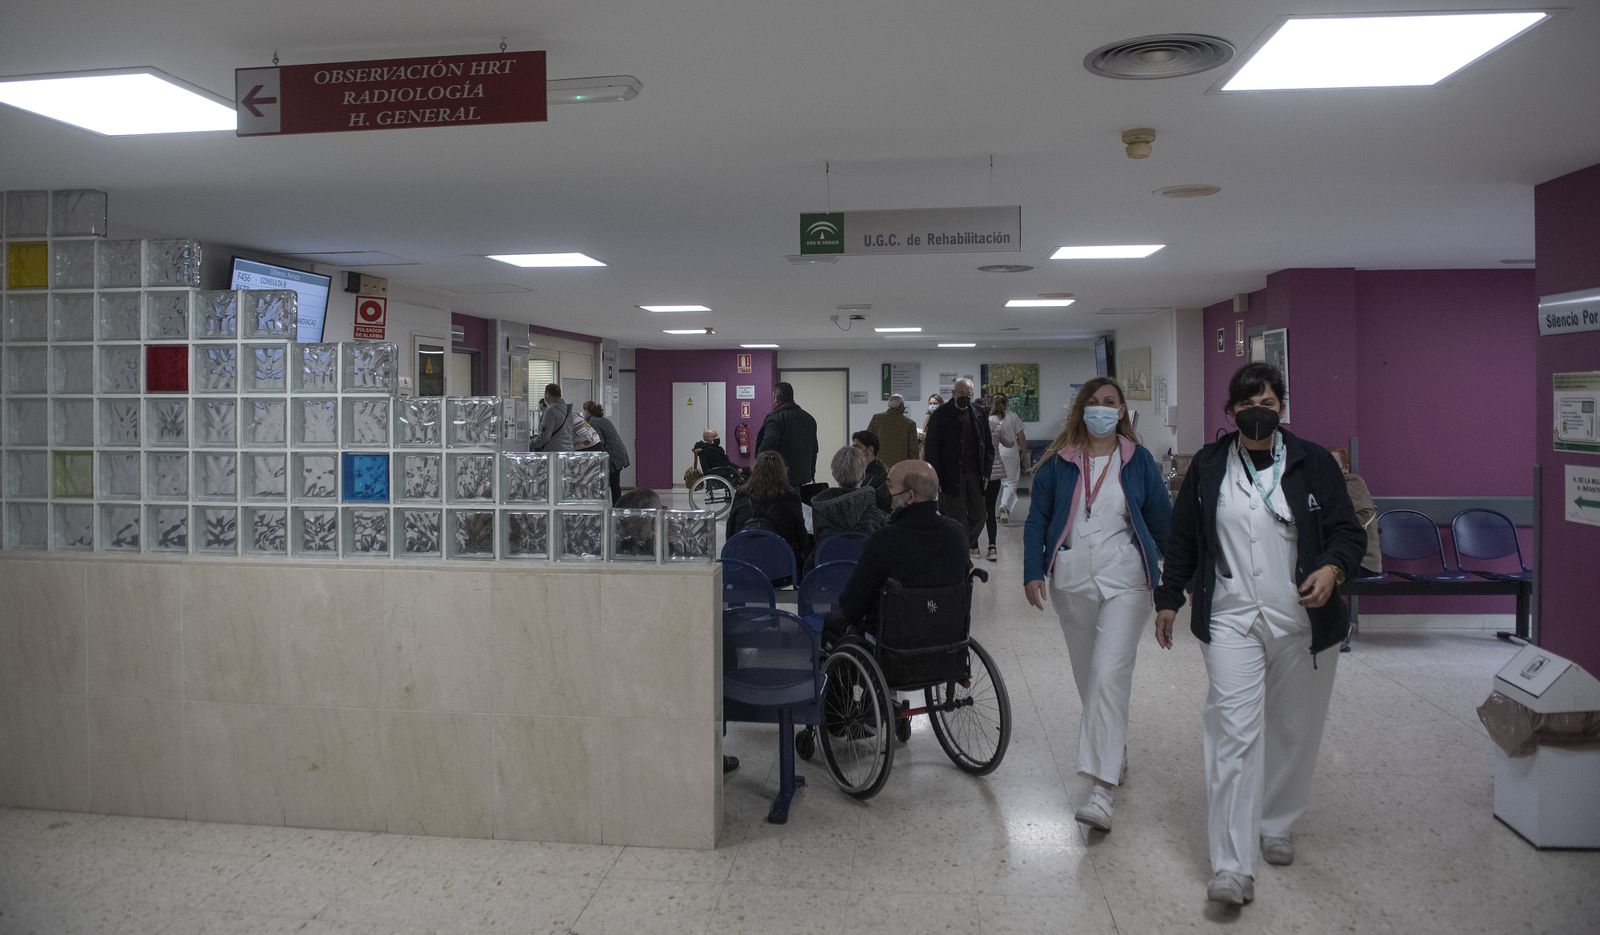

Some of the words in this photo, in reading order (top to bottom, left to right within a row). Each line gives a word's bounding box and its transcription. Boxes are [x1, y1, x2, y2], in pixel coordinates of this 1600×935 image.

[313, 60, 464, 85] OBSERVACIÓN
[469, 59, 517, 76] HRT
[342, 80, 485, 105] RADIOLOGÍA
[347, 112, 370, 127] H.
[376, 106, 481, 125] GENERAL
[863, 233, 901, 247] U.G.C.
[907, 233, 921, 246] de
[927, 231, 1010, 246] Rehabilitación
[1546, 312, 1579, 328] Silencio
[1582, 309, 1599, 325] Por
